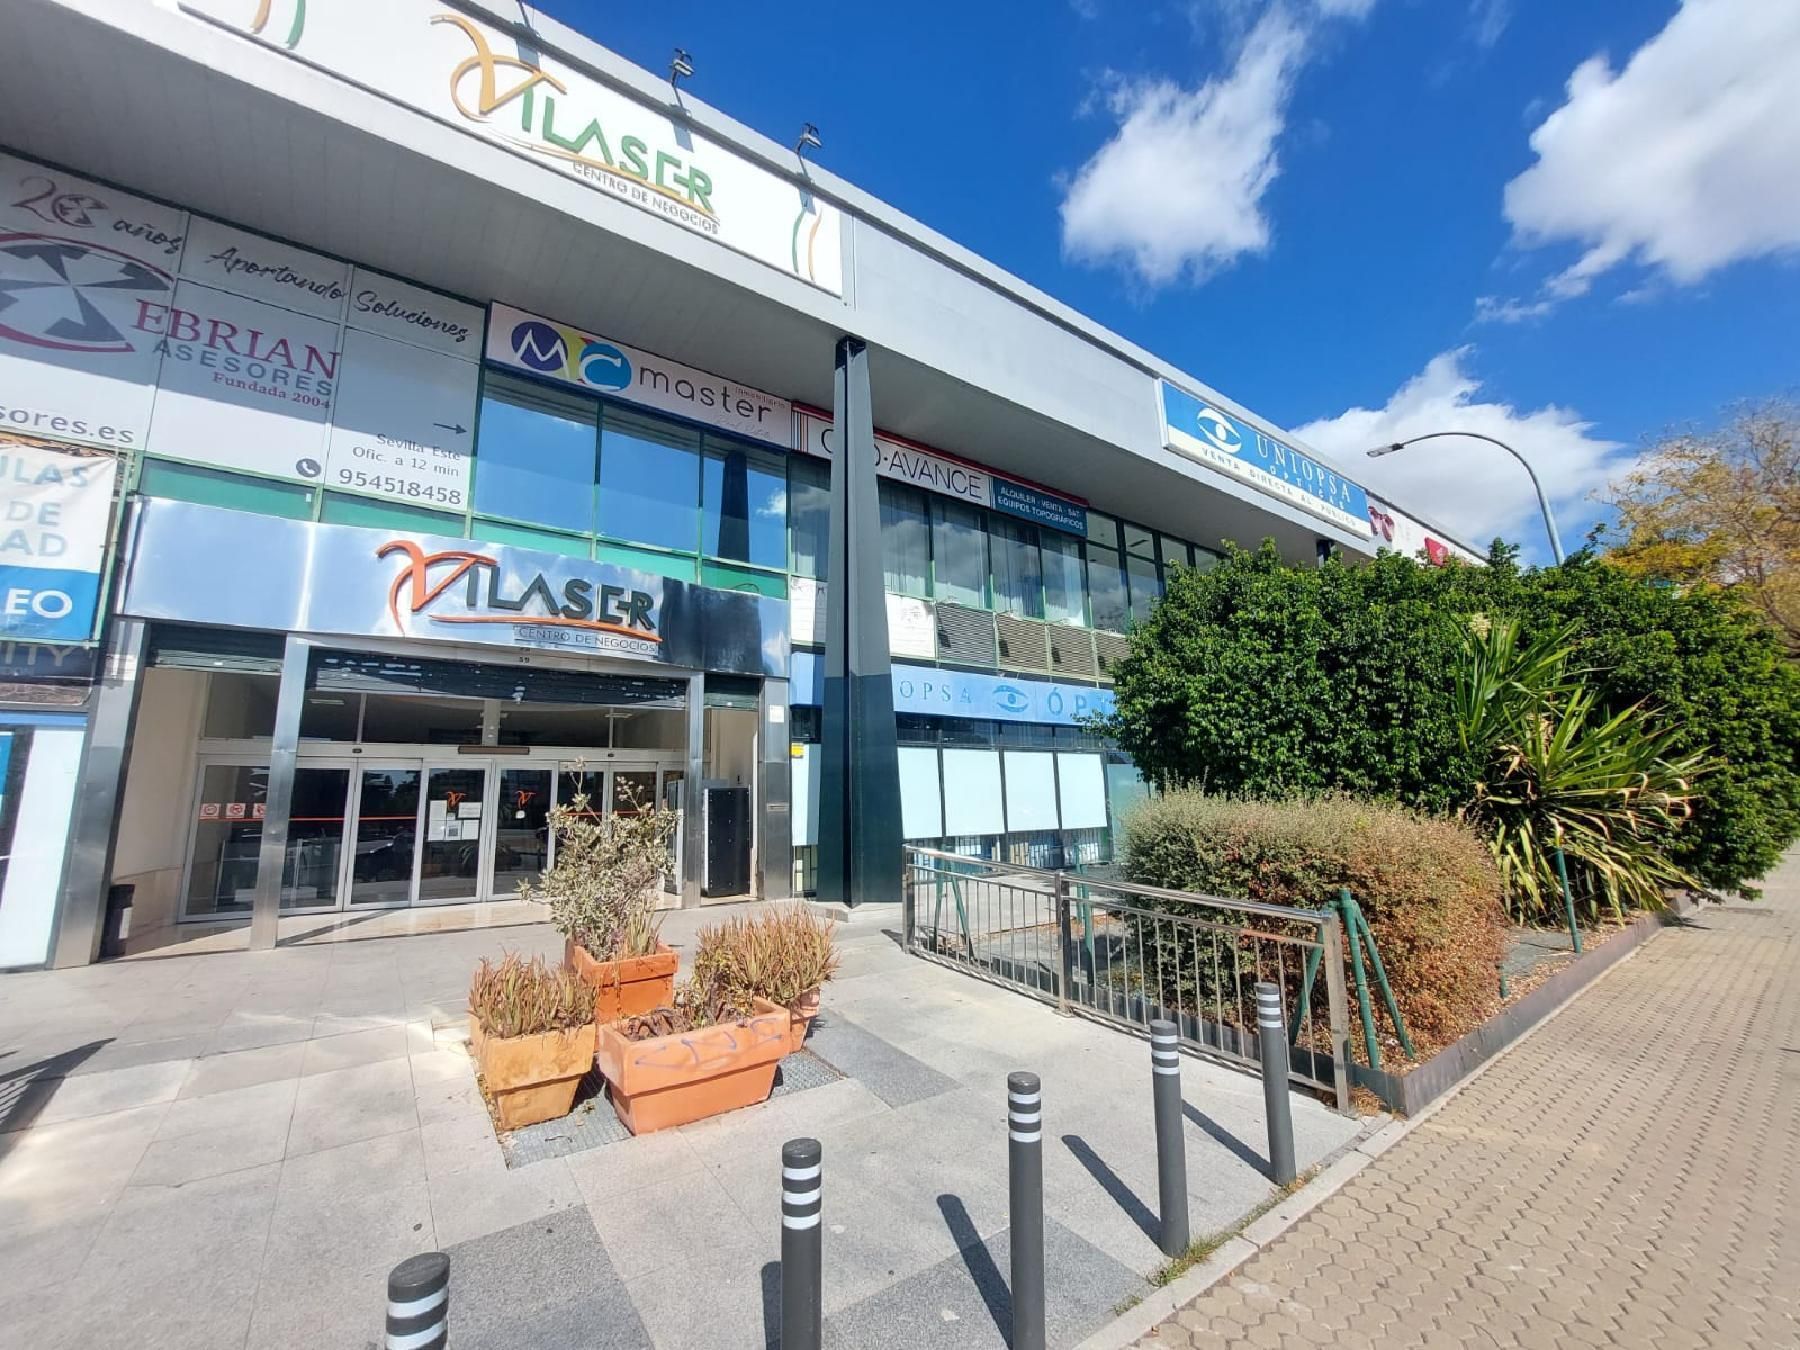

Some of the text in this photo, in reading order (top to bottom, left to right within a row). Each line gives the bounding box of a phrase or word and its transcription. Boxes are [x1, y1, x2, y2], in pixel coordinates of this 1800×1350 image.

[573, 161, 628, 195] CENTRO
[631, 186, 648, 204] DE
[113, 219, 183, 255] años
[205, 247, 476, 343] Aportando Soluciones
[132, 298, 341, 380] EBRIAN
[153, 339, 333, 397] ASESORES
[212, 371, 331, 409] Fundada 2004
[639, 365, 773, 423] master
[376, 433, 460, 461] Sevilla Este
[395, 456, 403, 466] a
[411, 458, 427, 470] 12
[434, 464, 459, 477] min
[1256, 434, 1351, 503] UNIOPSA
[339, 468, 461, 505] 954518458
[997, 496, 1030, 513] EQUIPOS
[6, 500, 62, 527] DE
[5, 587, 73, 619] EO
[519, 627, 656, 653] CENTRO DE NEGOCIOS
